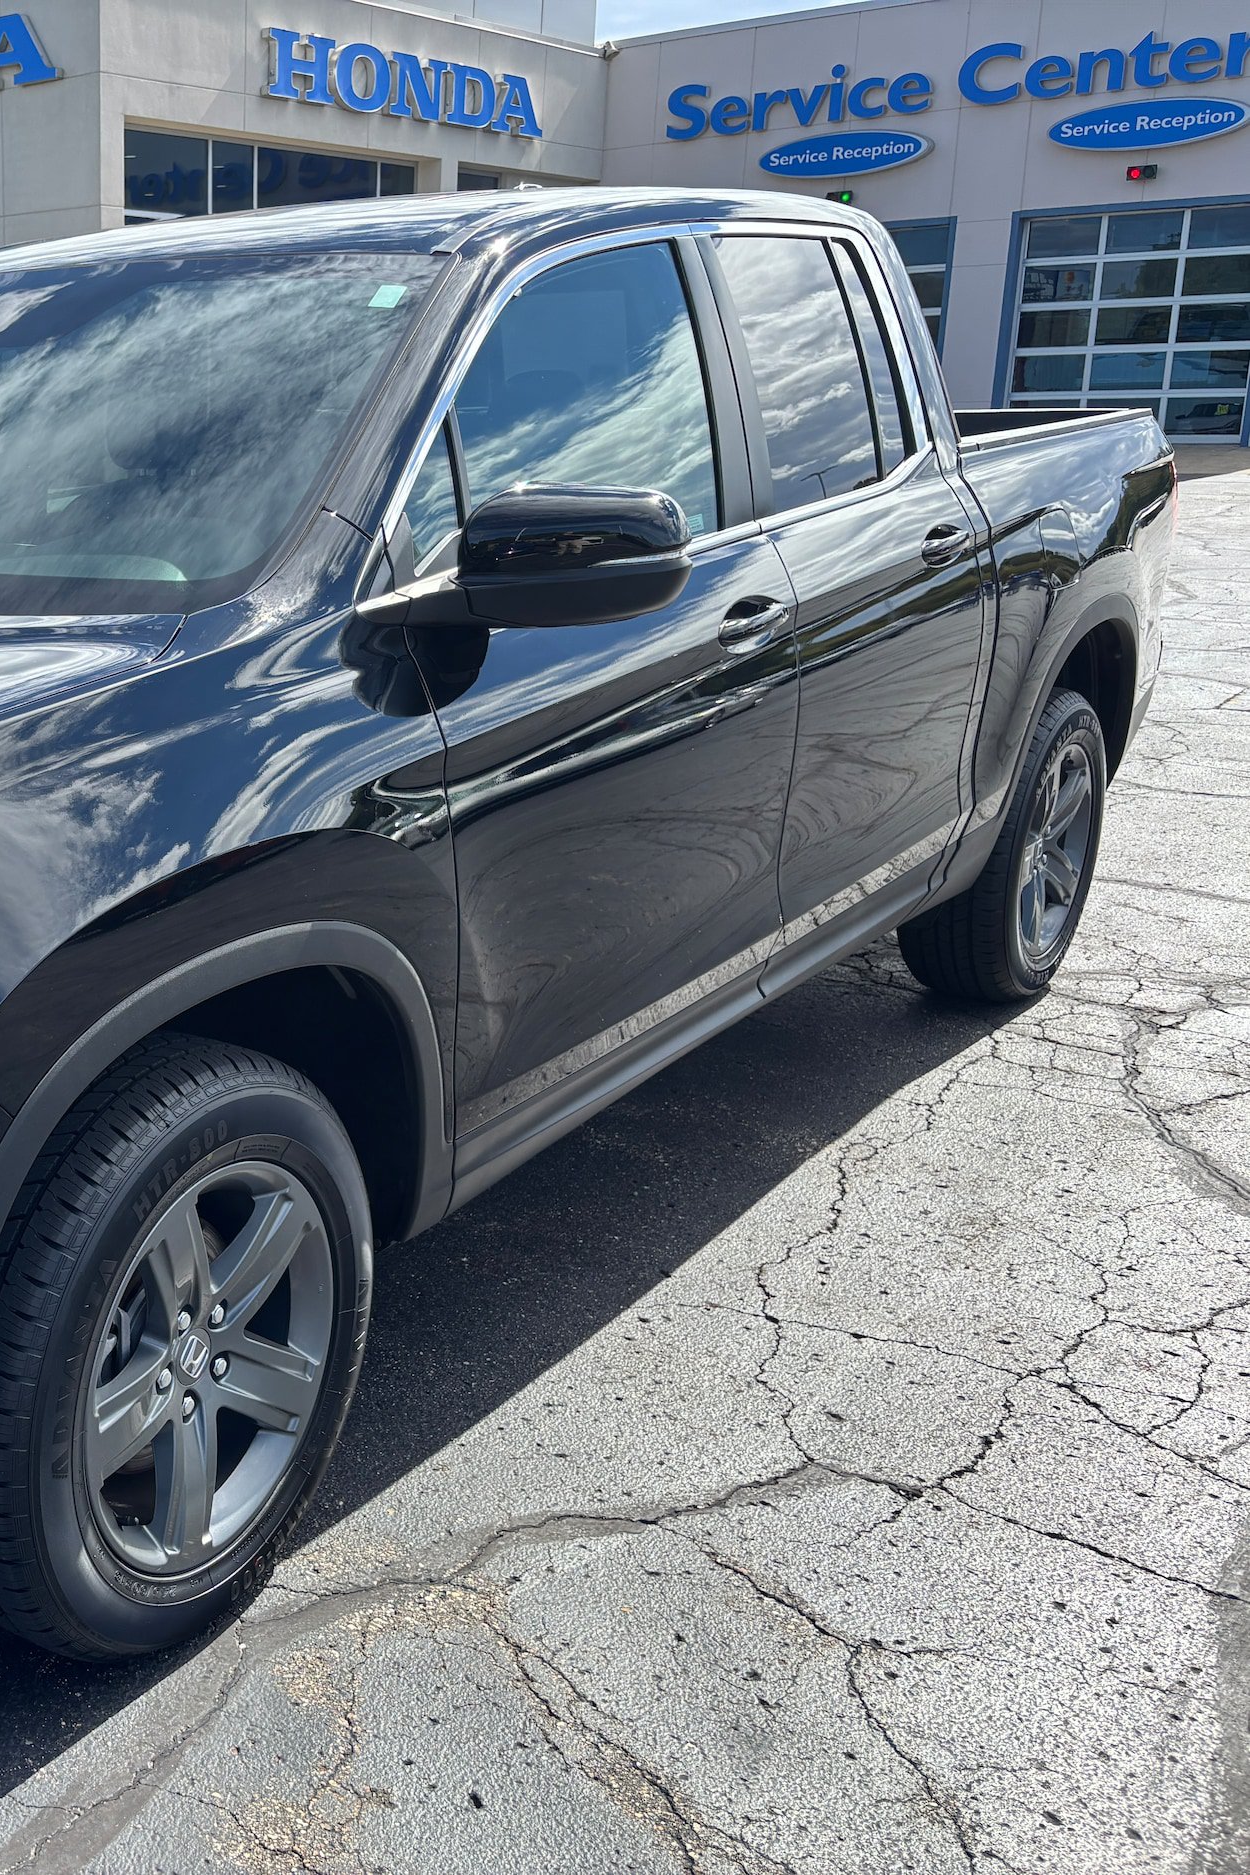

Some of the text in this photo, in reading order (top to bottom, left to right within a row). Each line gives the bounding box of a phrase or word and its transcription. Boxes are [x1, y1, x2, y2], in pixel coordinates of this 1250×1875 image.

[264, 27, 543, 138] HONDA
[665, 30, 1250, 140] Service Center
[769, 141, 915, 167] Service Reception
[1060, 109, 1236, 138] Service Reception
